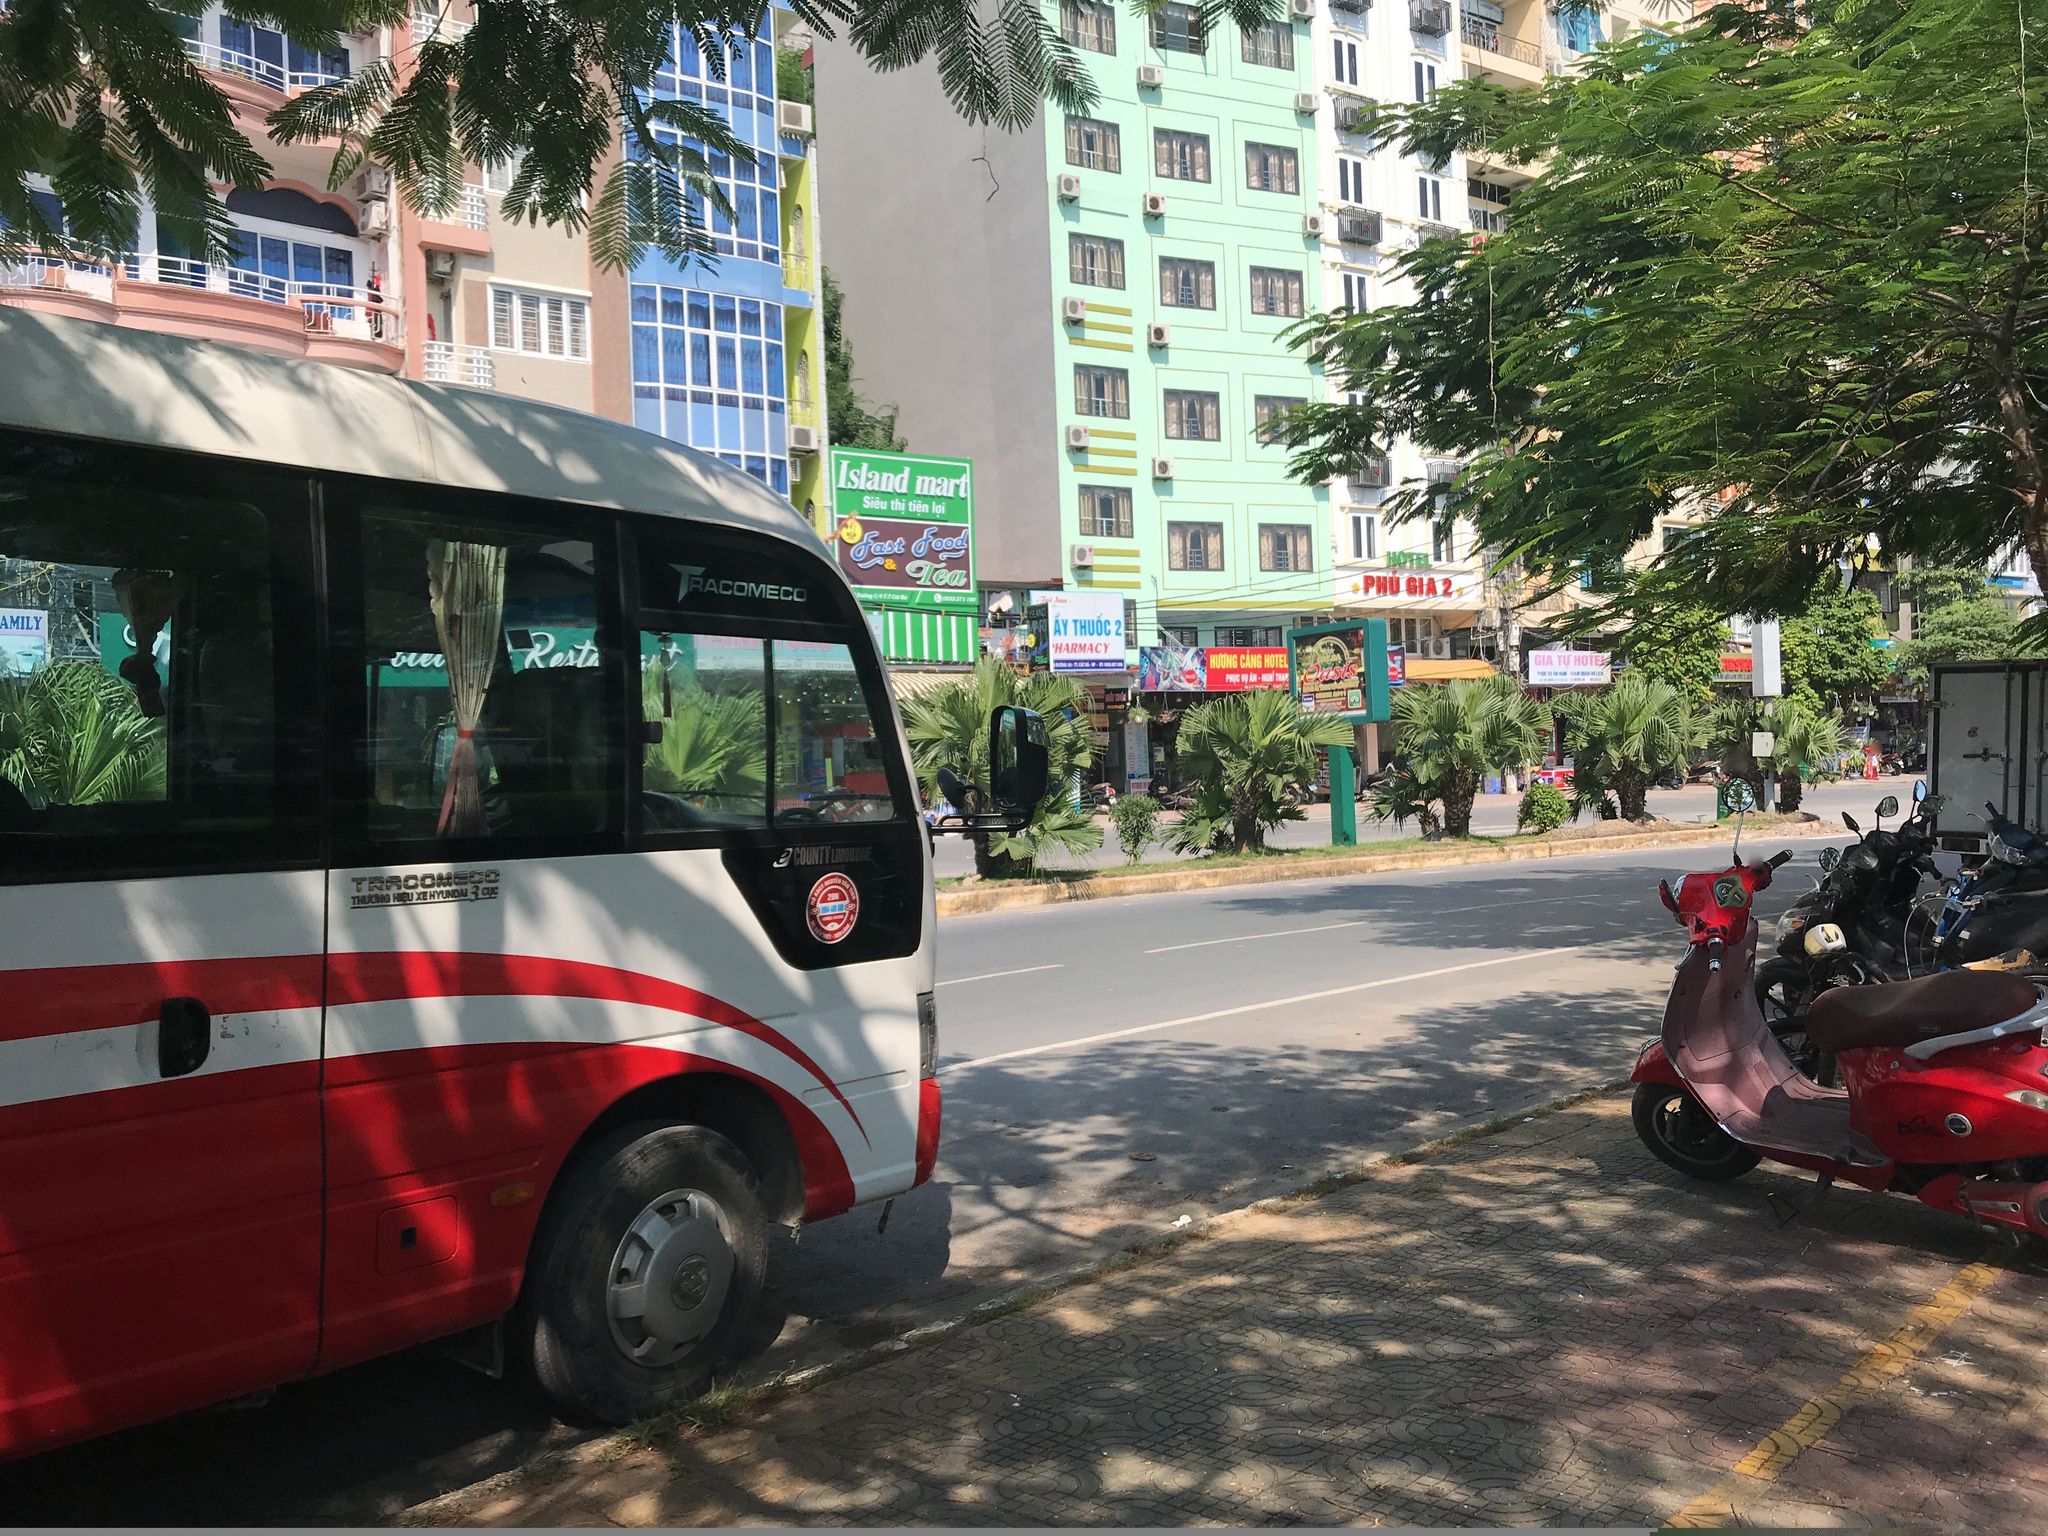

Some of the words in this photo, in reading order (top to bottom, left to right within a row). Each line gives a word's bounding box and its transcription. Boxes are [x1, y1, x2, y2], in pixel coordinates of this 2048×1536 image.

[837, 460, 910, 493] Island
[915, 473, 968, 498] mart
[863, 495, 887, 510] Siêu
[890, 498, 906, 515] thị
[908, 501, 929, 516] tiện
[932, 501, 946, 518] lợi
[850, 531, 905, 562] Fast
[911, 527, 969, 558] Food
[884, 558, 897, 571] &
[1386, 551, 1432, 569] HOTEL
[668, 563, 807, 602] TRACOMECO
[905, 560, 968, 587] Tea
[1405, 576, 1437, 597] GIA
[1442, 578, 1453, 597] 2
[1072, 612, 1111, 636] THUỐC
[1115, 619, 1122, 636] 2
[1053, 643, 1109, 654] HARMACY
[1264, 653, 1288, 669] HOTEL
[1534, 655, 1553, 666] GIA
[1303, 661, 1358, 684] Oasis
[794, 846, 831, 866] COUNTY
[351, 869, 500, 893] TRACOMECO
[416, 891, 428, 901] XE
[429, 888, 468, 900] HYUNDAI
